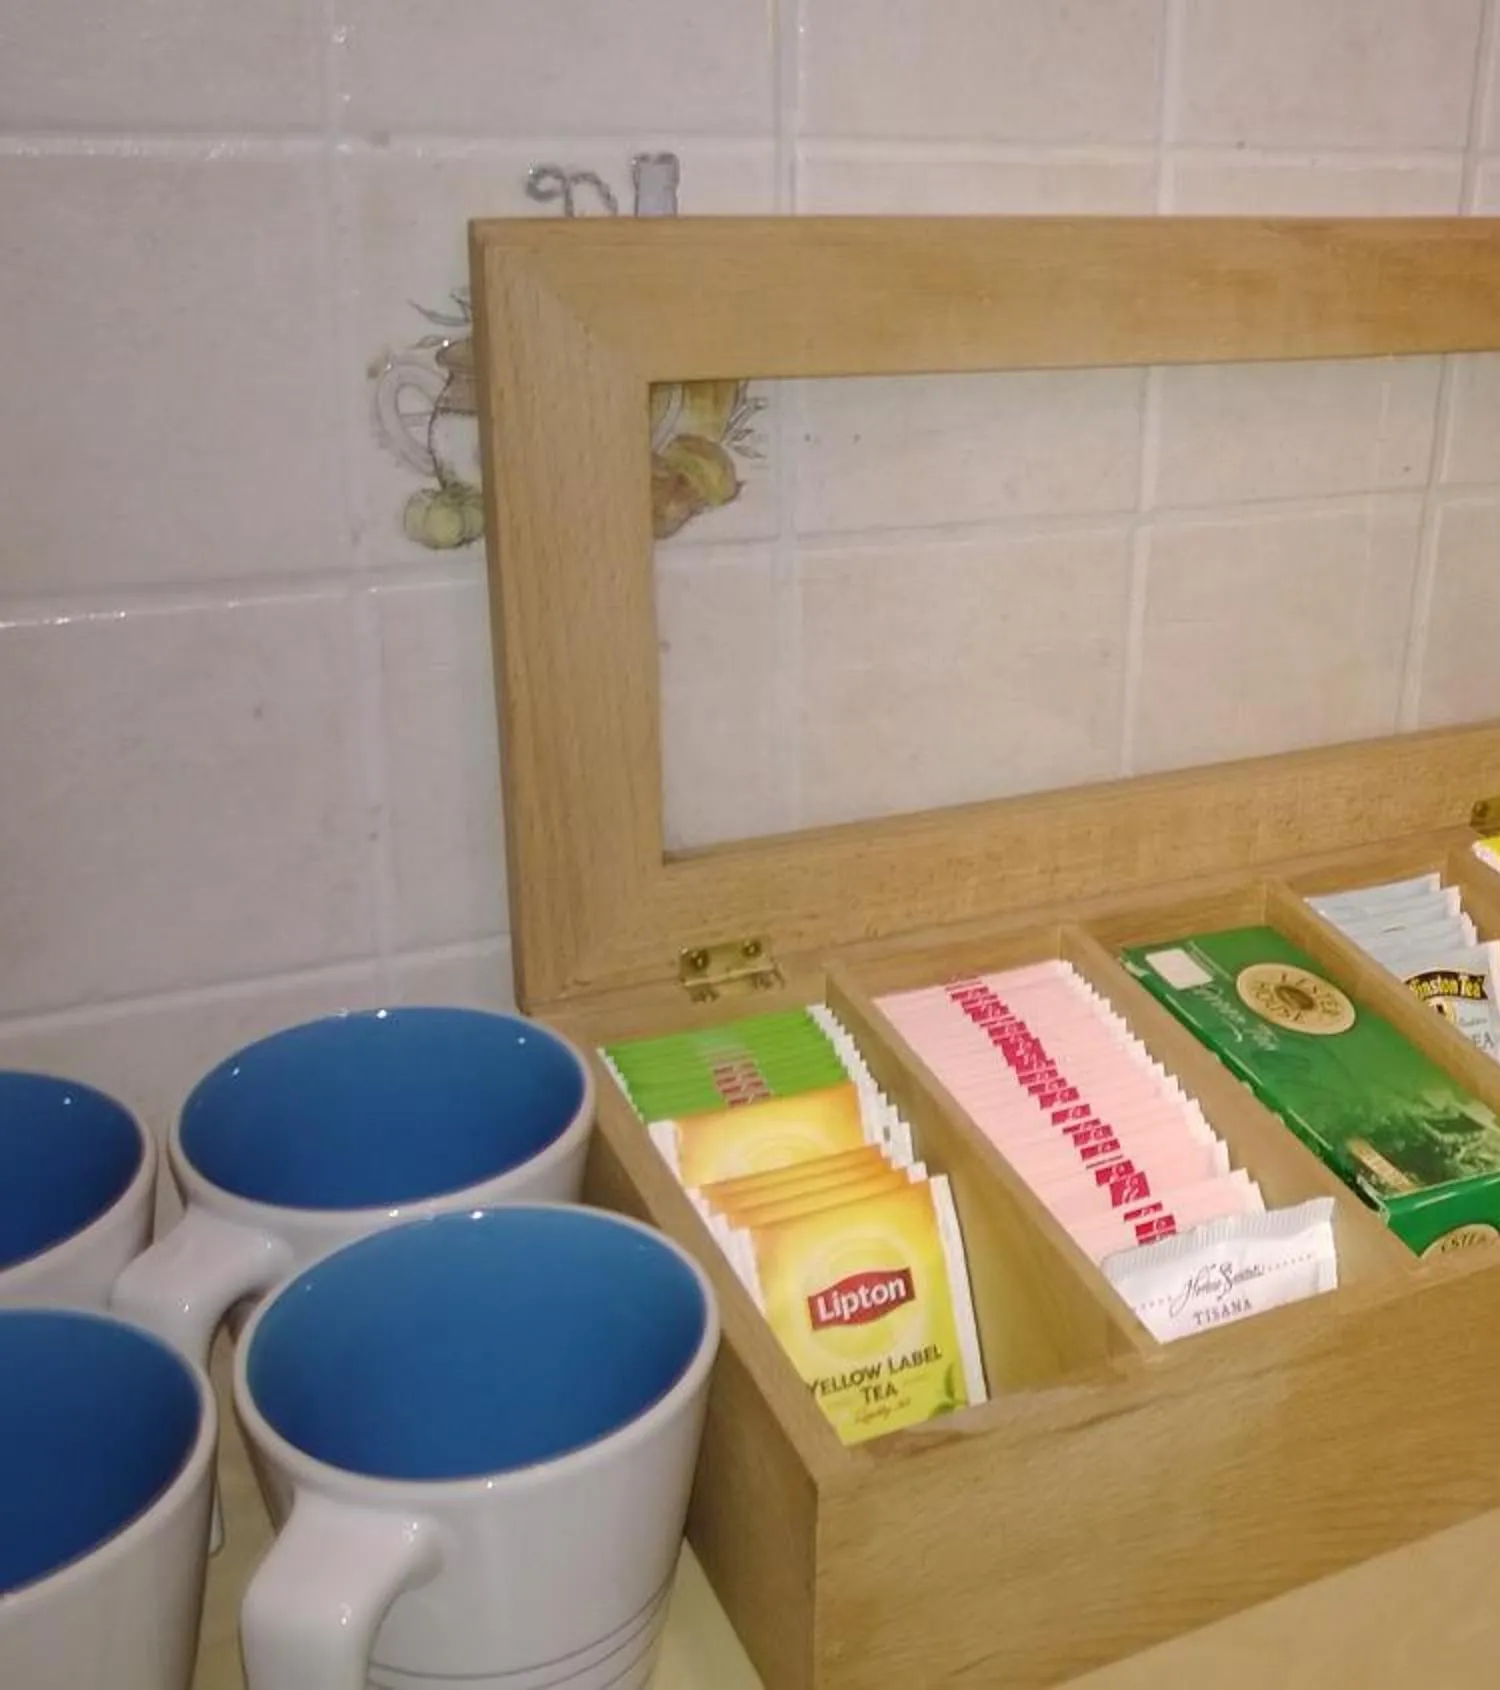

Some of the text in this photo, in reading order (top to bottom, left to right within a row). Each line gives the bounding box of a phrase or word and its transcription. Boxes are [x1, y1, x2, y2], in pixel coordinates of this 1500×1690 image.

[816, 1277, 907, 1324] Lipton
[1192, 1297, 1252, 1327] TISANA
[887, 1343, 943, 1374] LABEL
[859, 1380, 899, 1405] TEA
